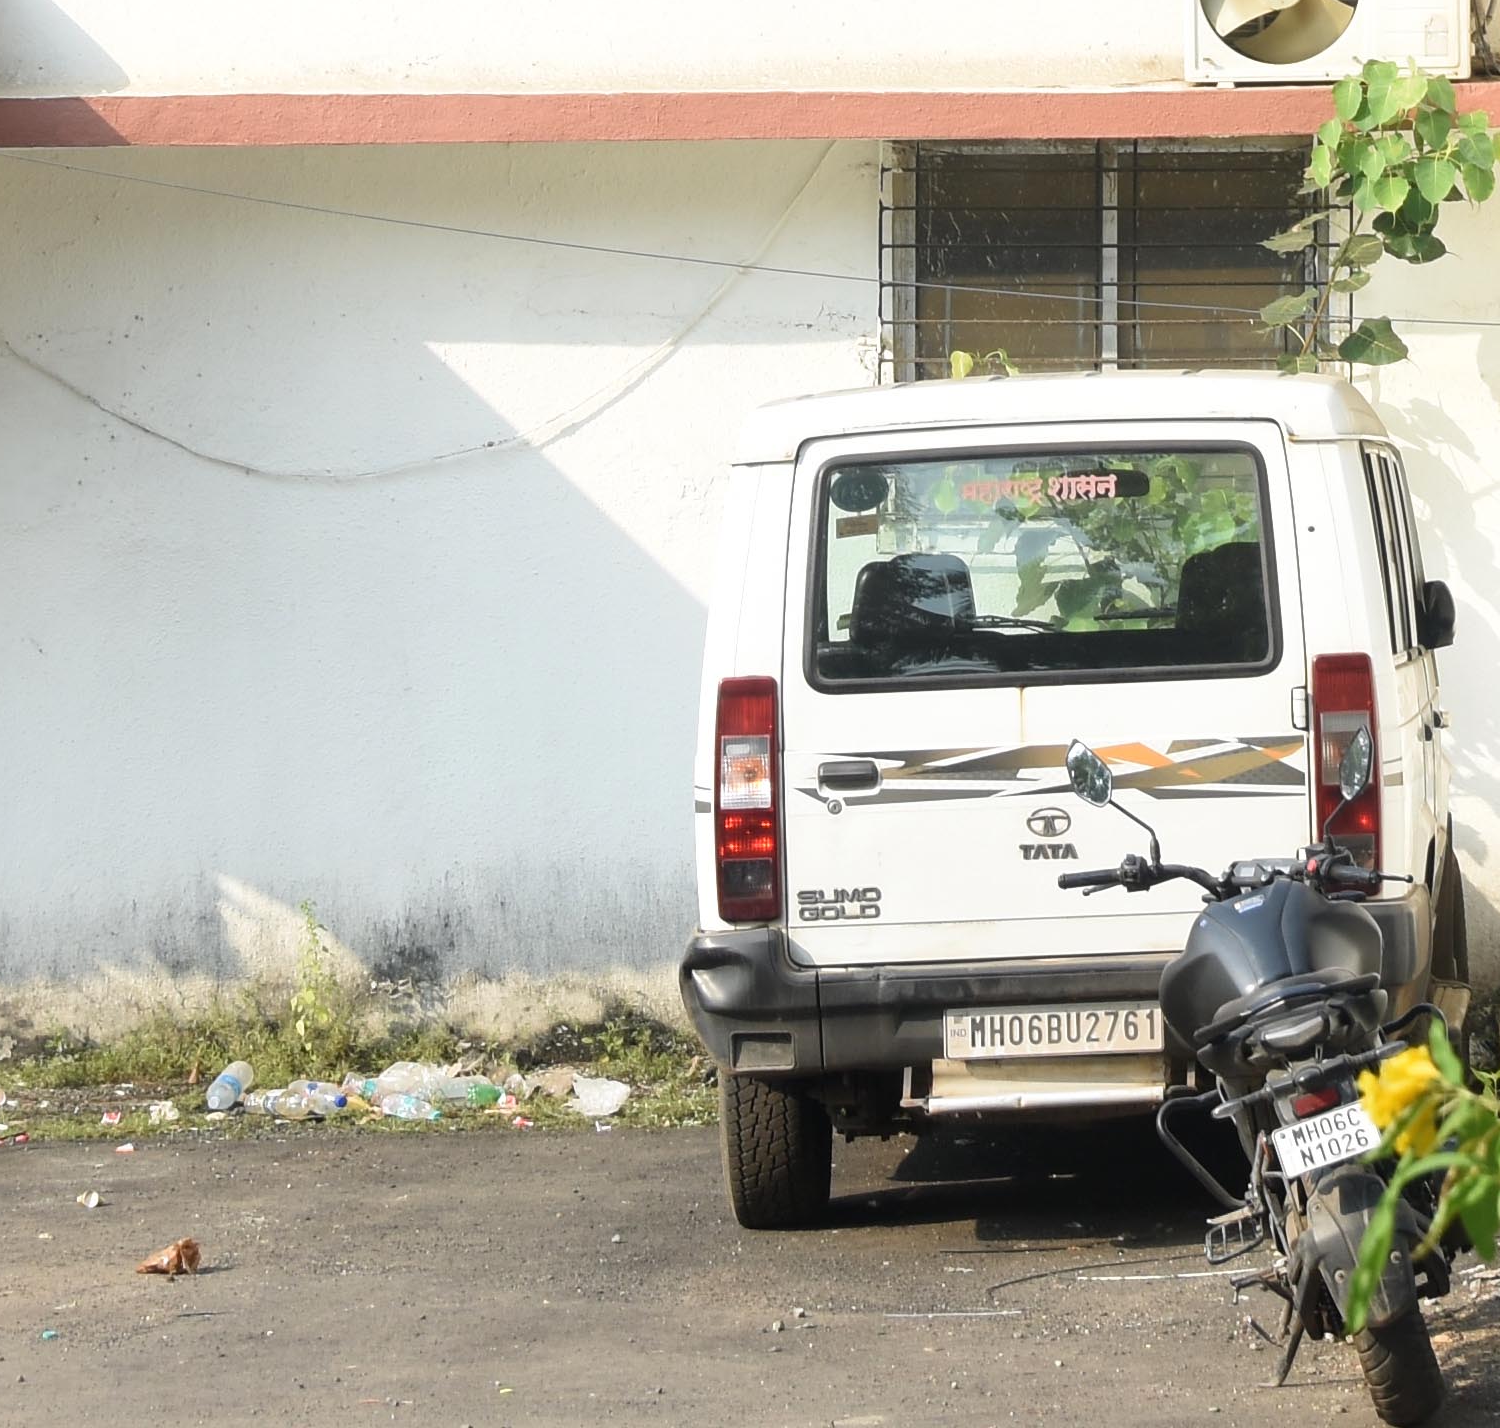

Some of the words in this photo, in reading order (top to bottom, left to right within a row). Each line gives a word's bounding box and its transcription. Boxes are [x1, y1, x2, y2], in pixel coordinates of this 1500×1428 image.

[1047, 475, 1117, 500] शासन
[1019, 844, 1079, 860] TATA
[797, 887, 881, 905] SUMO
[799, 904, 881, 921] GOLD
[950, 1028, 967, 1038] IND
[971, 1009, 1155, 1047] MH06BU2761
[1292, 1108, 1360, 1146] MH06C
[1300, 1129, 1369, 1167] N1026
